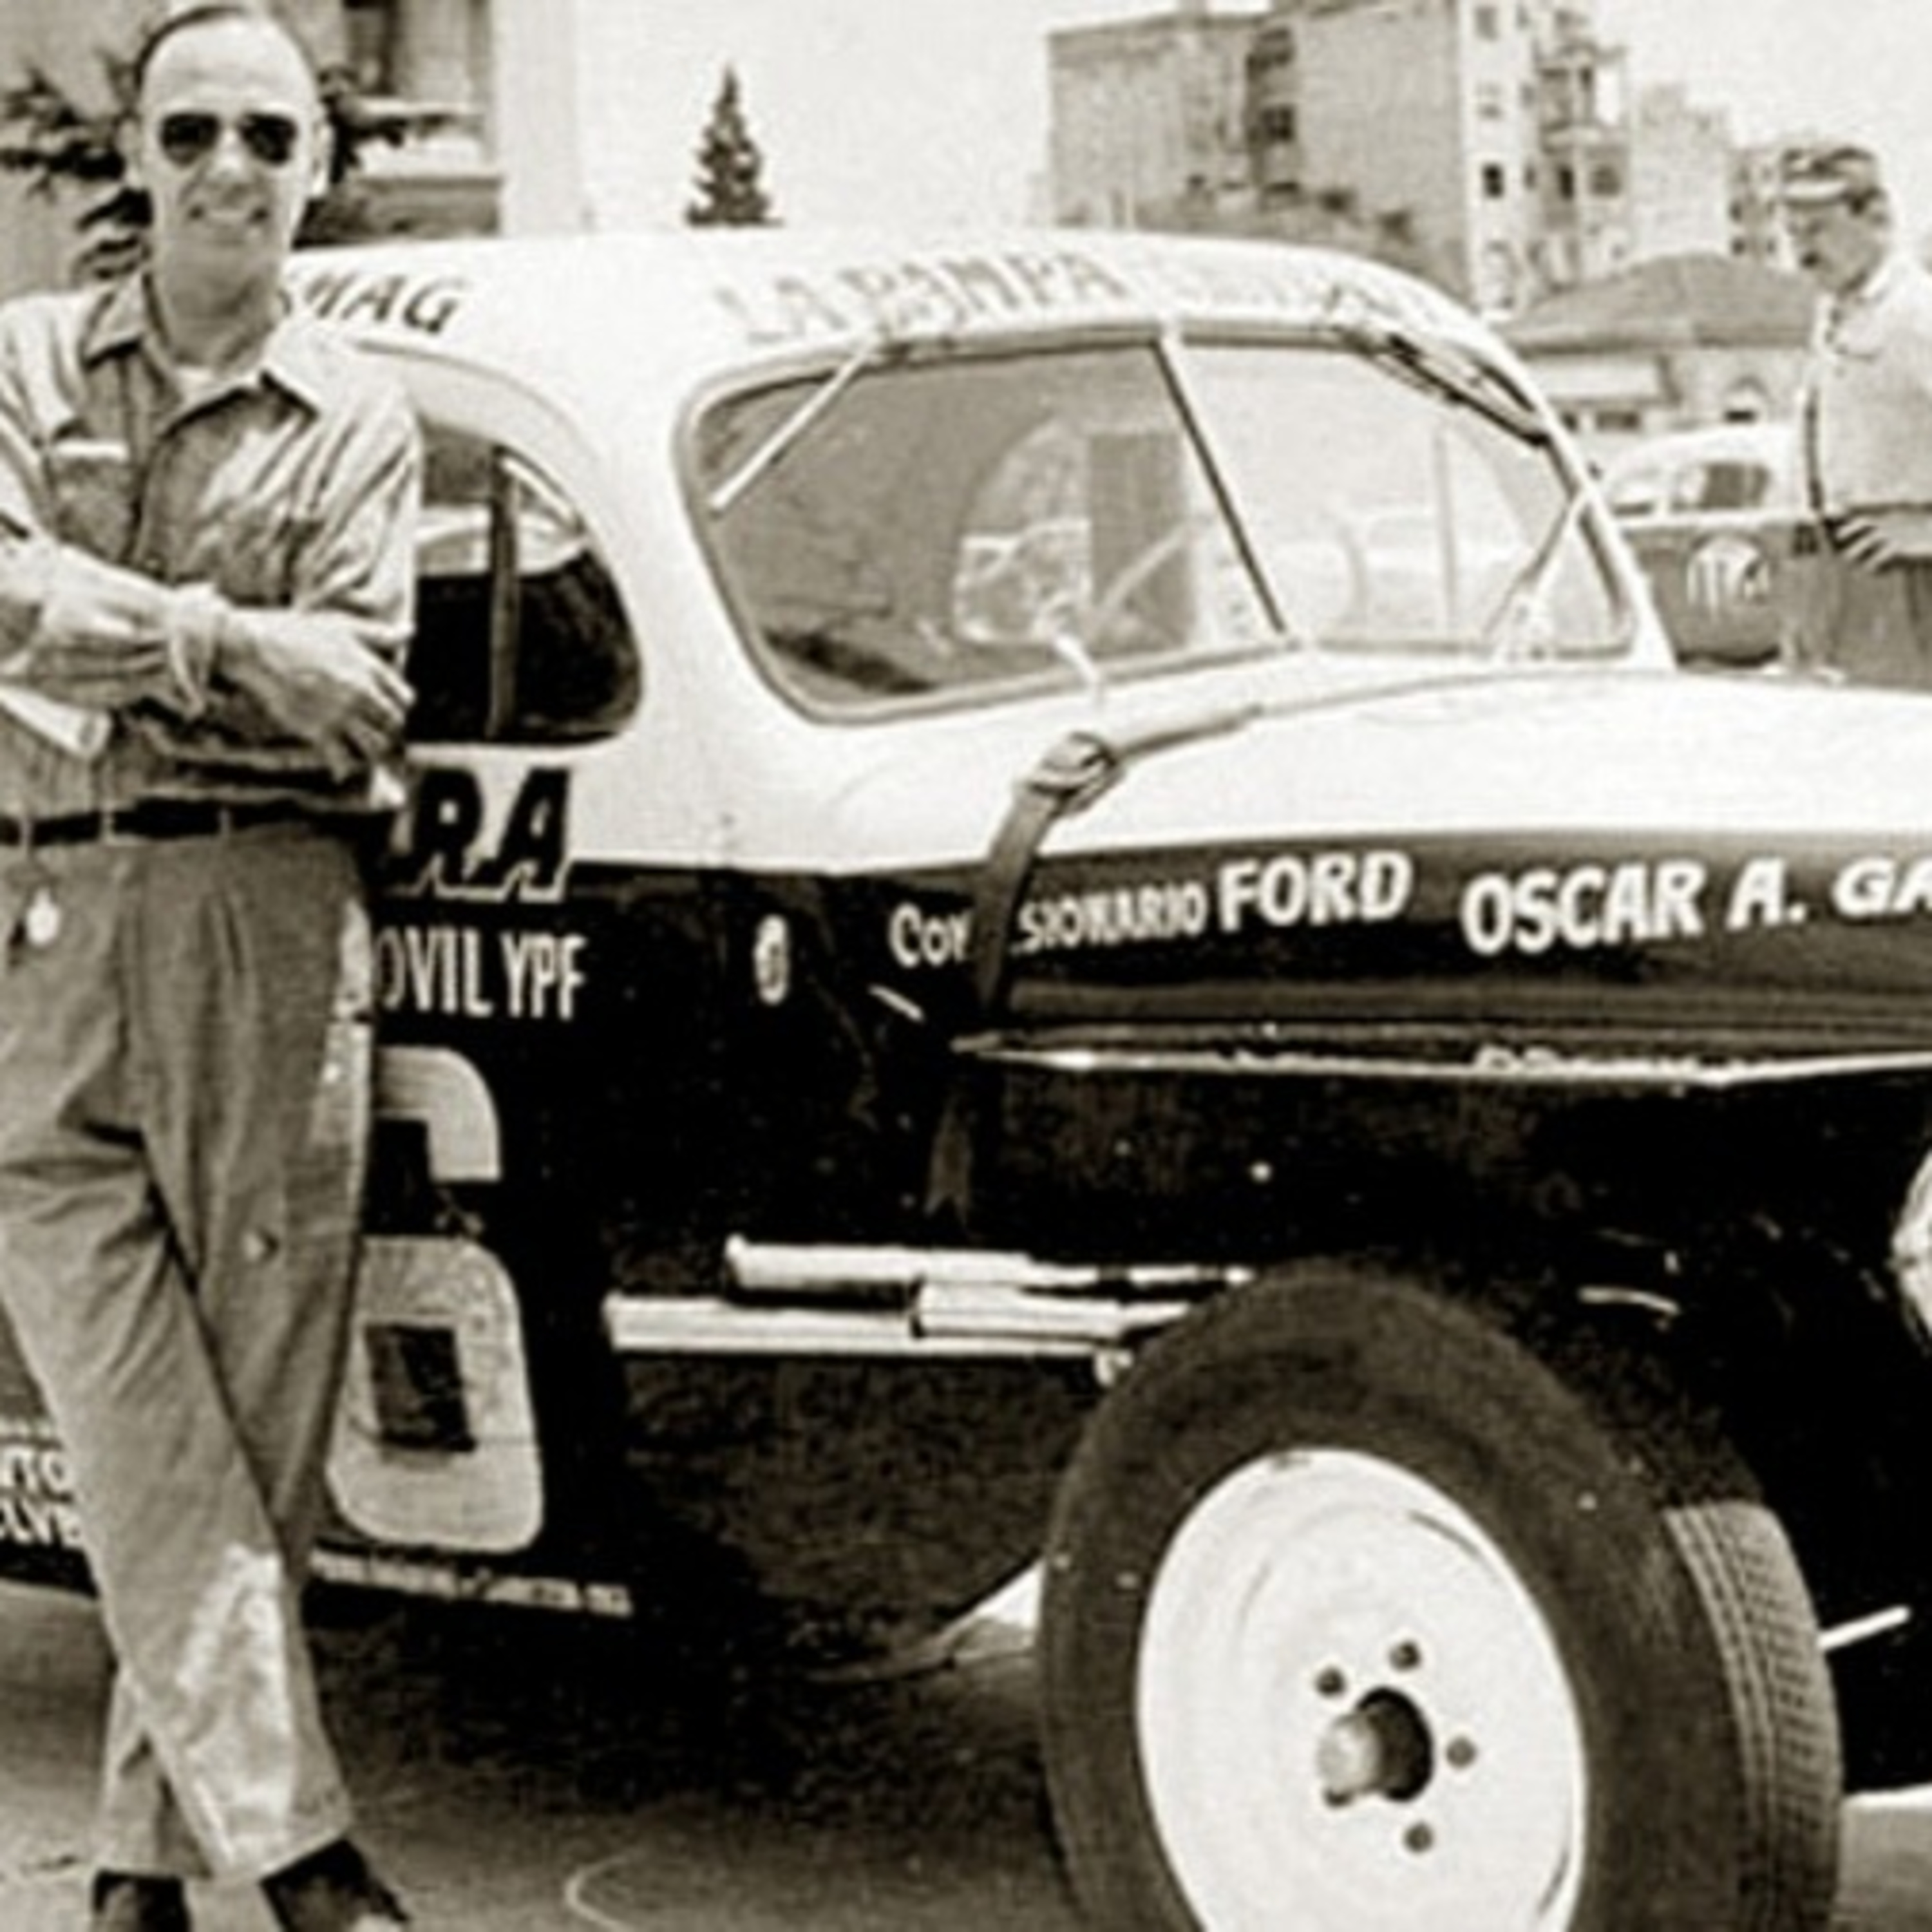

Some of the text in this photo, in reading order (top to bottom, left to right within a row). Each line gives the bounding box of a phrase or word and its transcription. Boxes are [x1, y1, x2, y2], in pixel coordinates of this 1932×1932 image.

[1217, 850, 1412, 933] FORD
[1461, 859, 1707, 957] OSCAR
[1726, 857, 1807, 932] A.
[500, 931, 587, 1020] YPF
